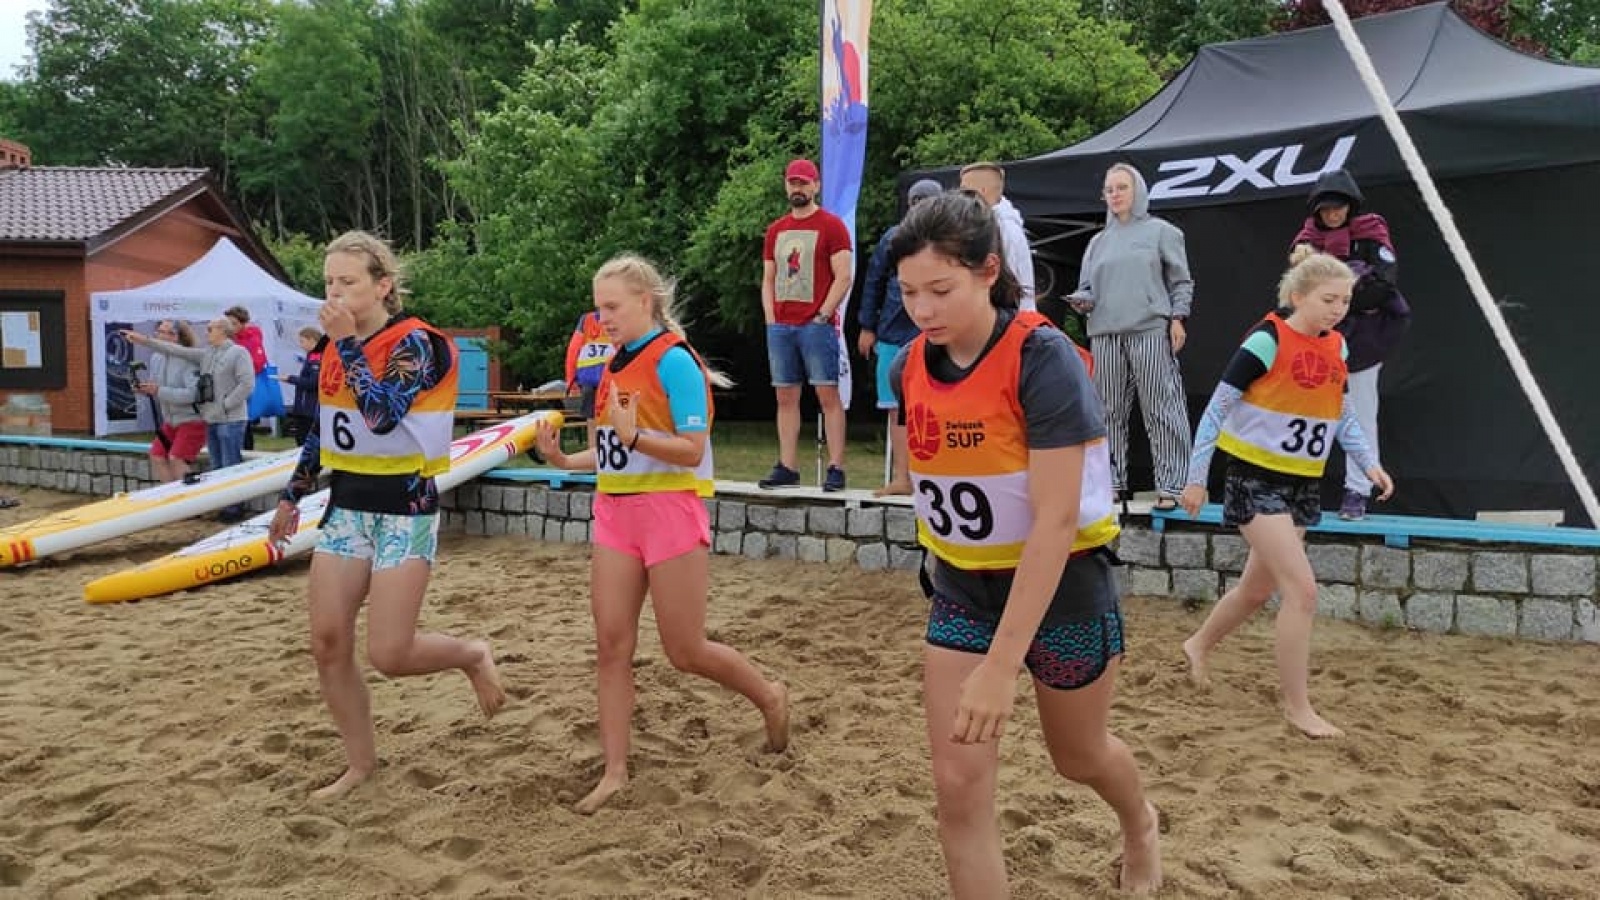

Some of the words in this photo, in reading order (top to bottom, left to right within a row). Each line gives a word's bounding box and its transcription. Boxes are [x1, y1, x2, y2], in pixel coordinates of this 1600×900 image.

[1147, 135, 1357, 200] 2XU
[588, 344, 608, 357] 37
[333, 411, 355, 450] 6
[597, 429, 628, 470] 68
[946, 432, 985, 448] SUP
[1281, 418, 1327, 457] 38
[919, 480, 993, 540] 39
